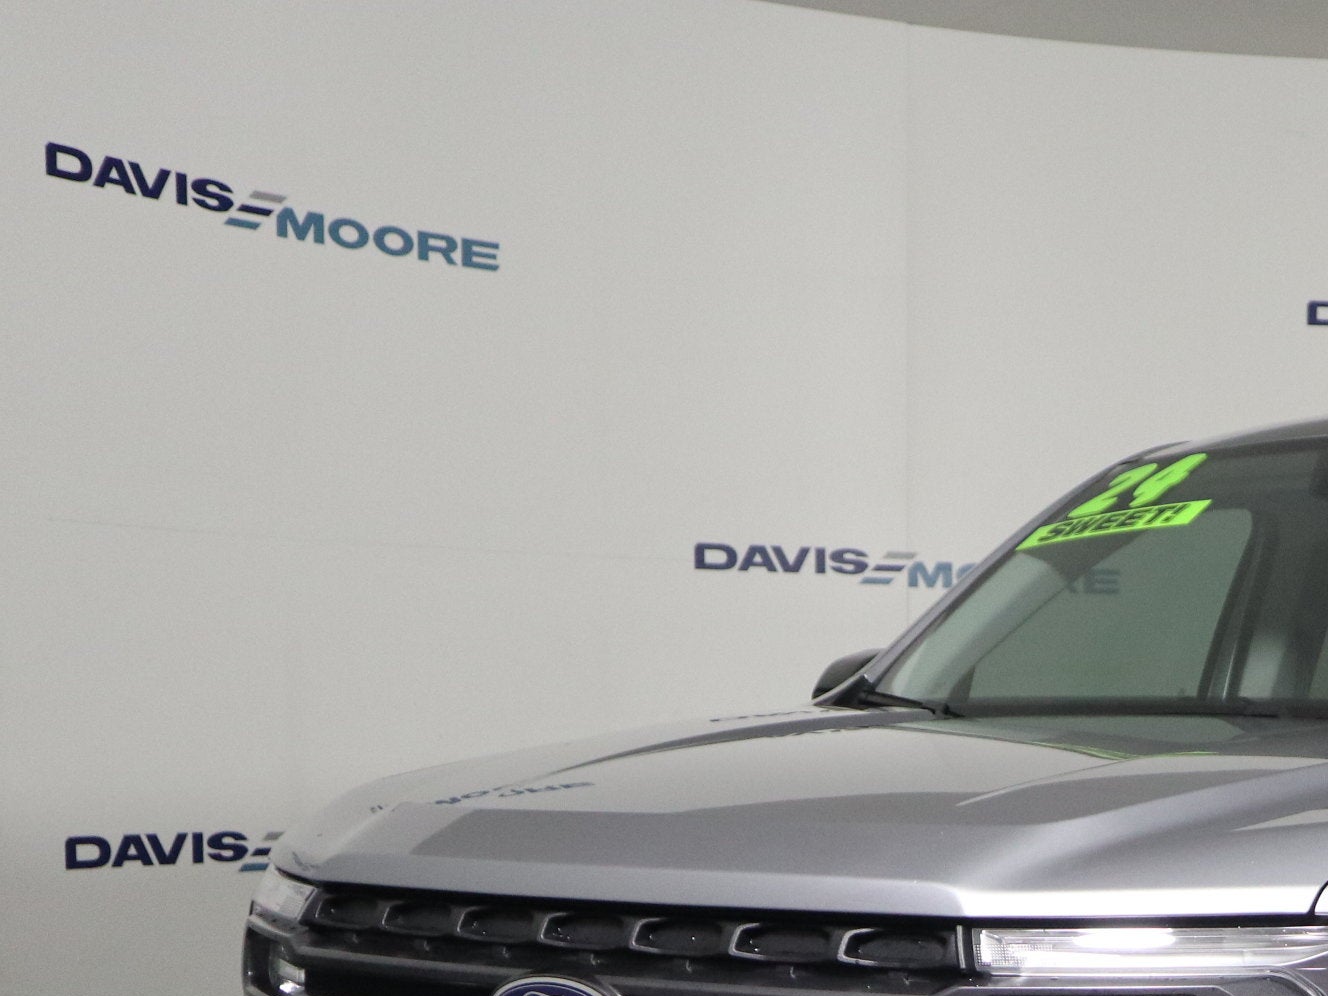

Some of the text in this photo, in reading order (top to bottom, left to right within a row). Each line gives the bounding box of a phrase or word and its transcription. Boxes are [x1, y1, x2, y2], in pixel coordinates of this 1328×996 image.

[45, 142, 500, 272] DAVIS MOORE
[1067, 453, 1208, 518] 24
[1037, 502, 1192, 542] SWEET!
[694, 541, 869, 575] DAVIS
[65, 831, 249, 870] DAVIS
